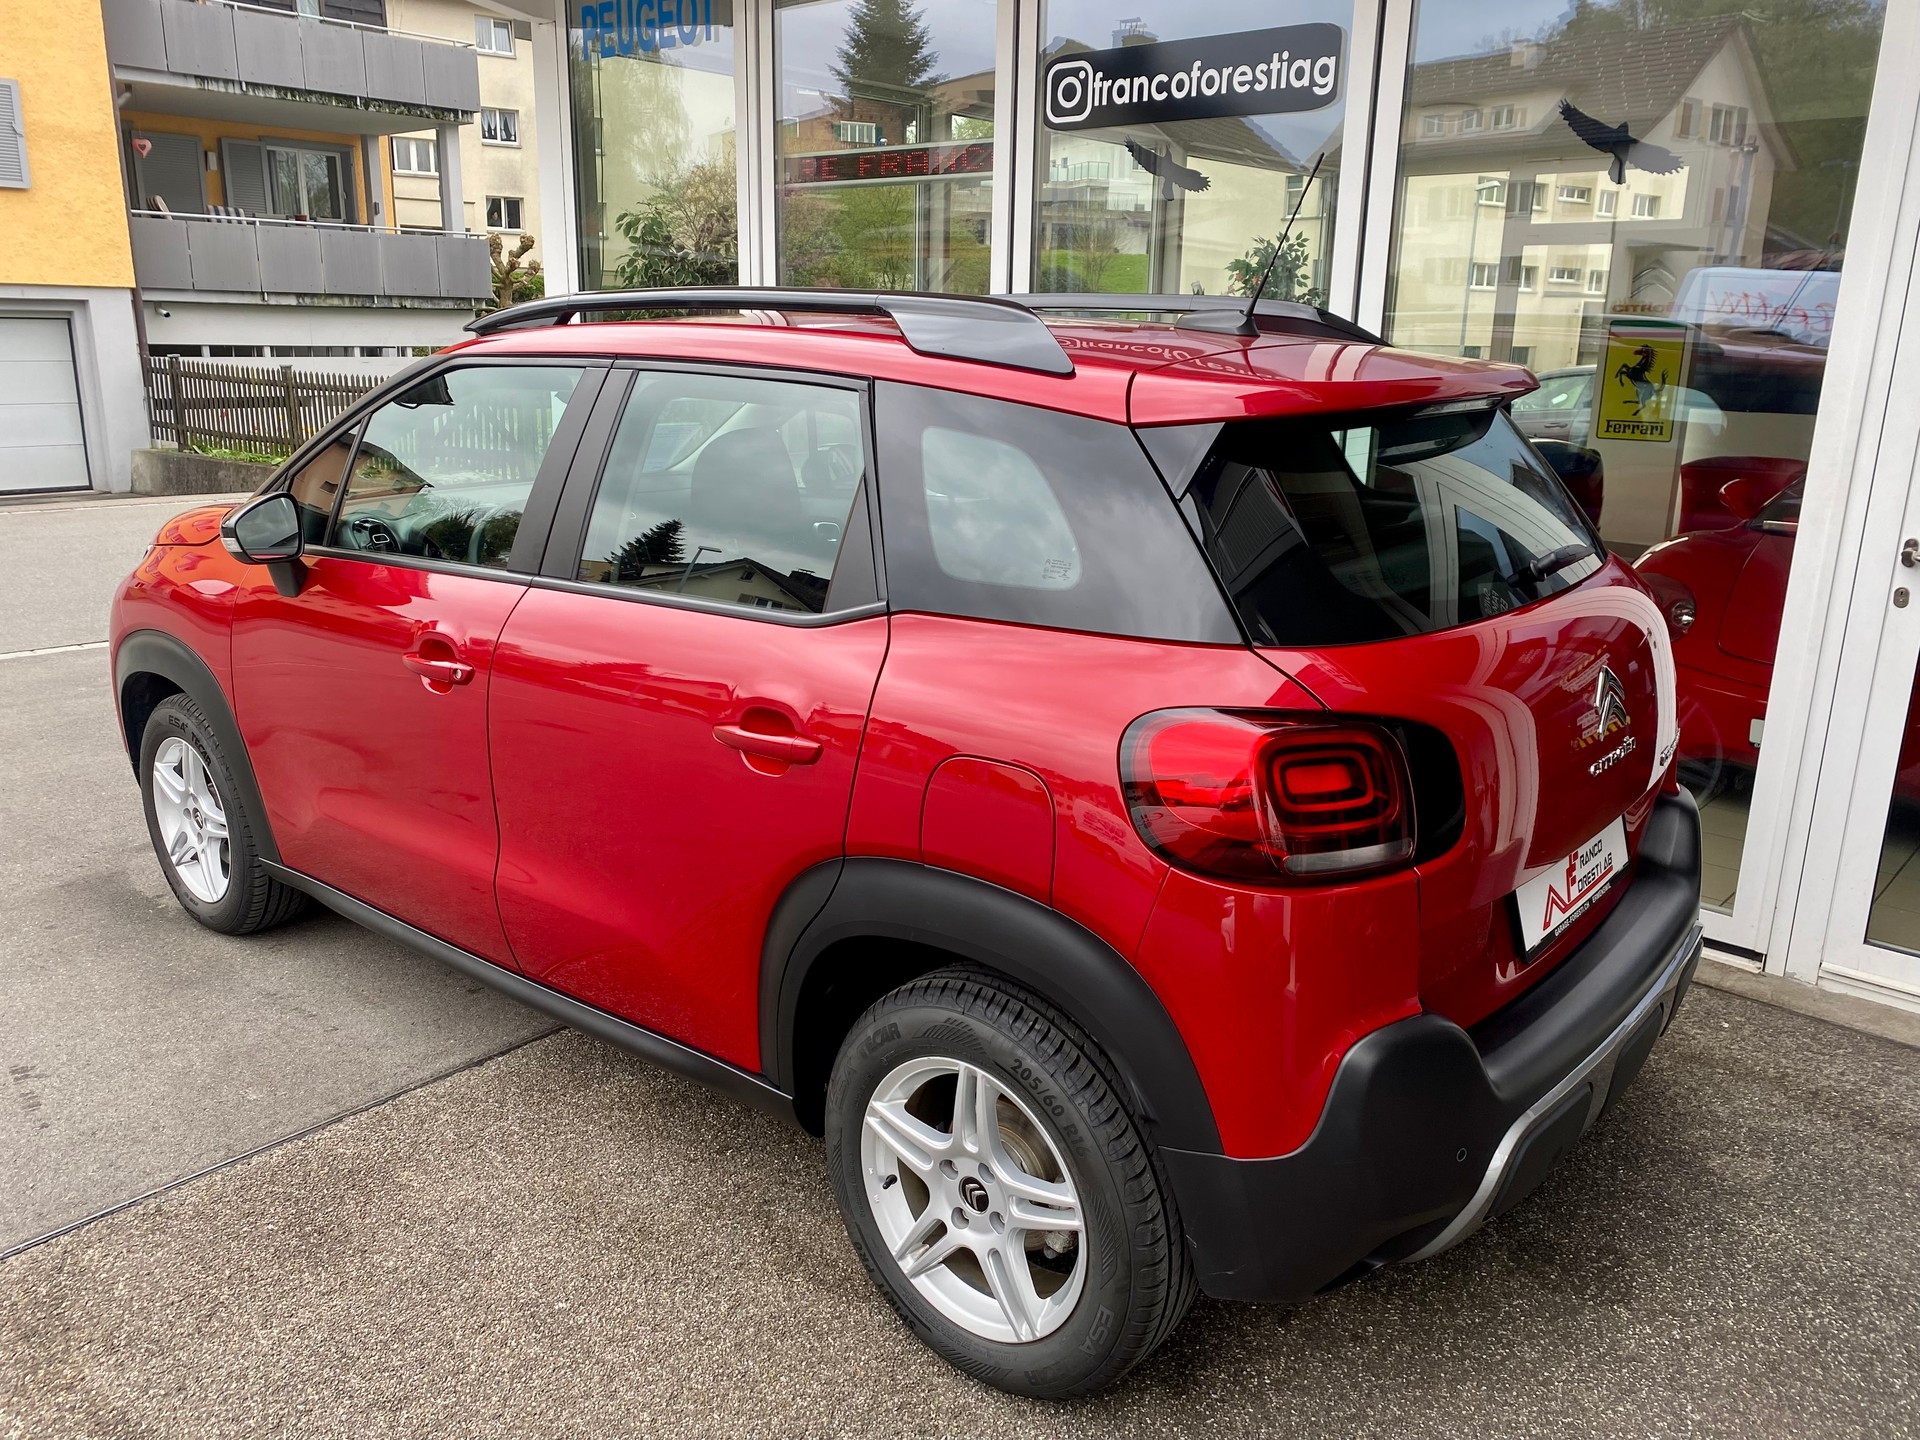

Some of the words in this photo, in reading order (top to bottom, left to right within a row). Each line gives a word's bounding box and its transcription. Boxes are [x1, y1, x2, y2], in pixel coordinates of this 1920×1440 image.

[1093, 50, 1337, 107] francoforestiag
[858, 146, 994, 177] FRANC
[1604, 419, 1664, 436] Ferrari
[1010, 1058, 1066, 1117] 205/60
